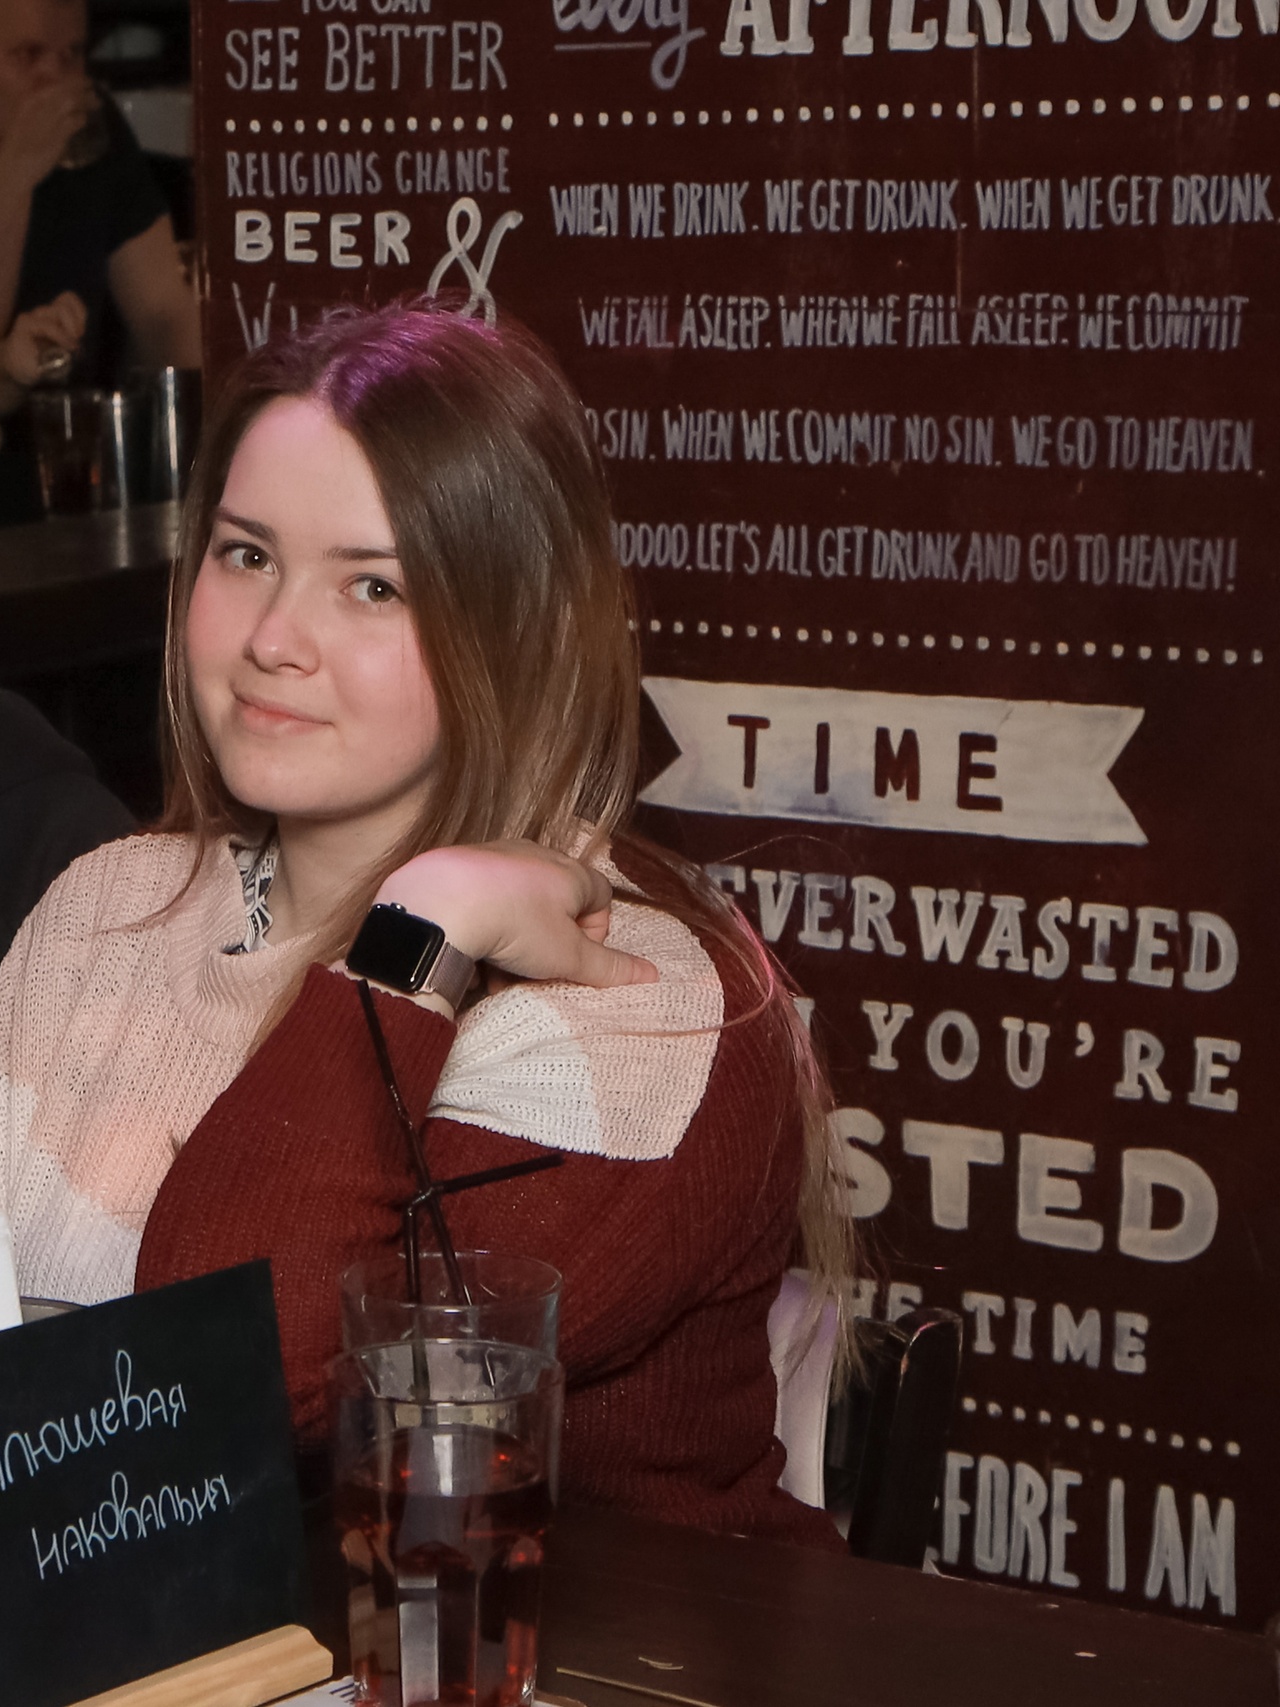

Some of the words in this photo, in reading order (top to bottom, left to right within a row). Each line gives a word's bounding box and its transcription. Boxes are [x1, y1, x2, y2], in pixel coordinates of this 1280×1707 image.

[225, 28, 300, 91] SEE
[325, 21, 507, 92] BETTER
[226, 150, 383, 198] RELIGIONS
[395, 148, 511, 195] CHANGE
[549, 183, 619, 237] WHEN
[628, 182, 665, 238] WE
[765, 178, 804, 233] WE
[810, 178, 862, 232] GET
[975, 177, 1051, 231] WHEN
[1061, 176, 1104, 231] WE
[1109, 174, 1163, 226] GET
[234, 209, 411, 268] BEER
[678, 294, 772, 350] ASLEEP.
[906, 294, 961, 348] FALL
[1078, 294, 1122, 349] WE
[1126, 292, 1249, 351] COMMIT
[663, 405, 733, 462] WHEN
[741, 408, 783, 463] WE
[786, 408, 897, 466] COMMIT
[904, 414, 940, 464] NO
[945, 415, 1002, 467] SIN.
[1011, 415, 1052, 468] WE
[1057, 415, 1097, 470] GO
[1104, 415, 1140, 470] TO
[696, 520, 761, 576] LET'S
[766, 523, 813, 578] ALL
[818, 525, 868, 579] GET
[872, 528, 961, 583] DRUNK
[962, 531, 1021, 584] AND
[1029, 532, 1067, 583] GO
[1074, 533, 1111, 586] TO
[1118, 534, 1238, 592] HEAVEN!
[727, 713, 1004, 812] TIME
[910, 885, 1240, 992] WASTED
[861, 999, 1242, 1113] YOU'RE
[827, 1107, 1219, 1264] STED
[962, 1290, 1149, 1374] TIME
[933, 1450, 1083, 1590] FORE
[1107, 1476, 1127, 1593] I
